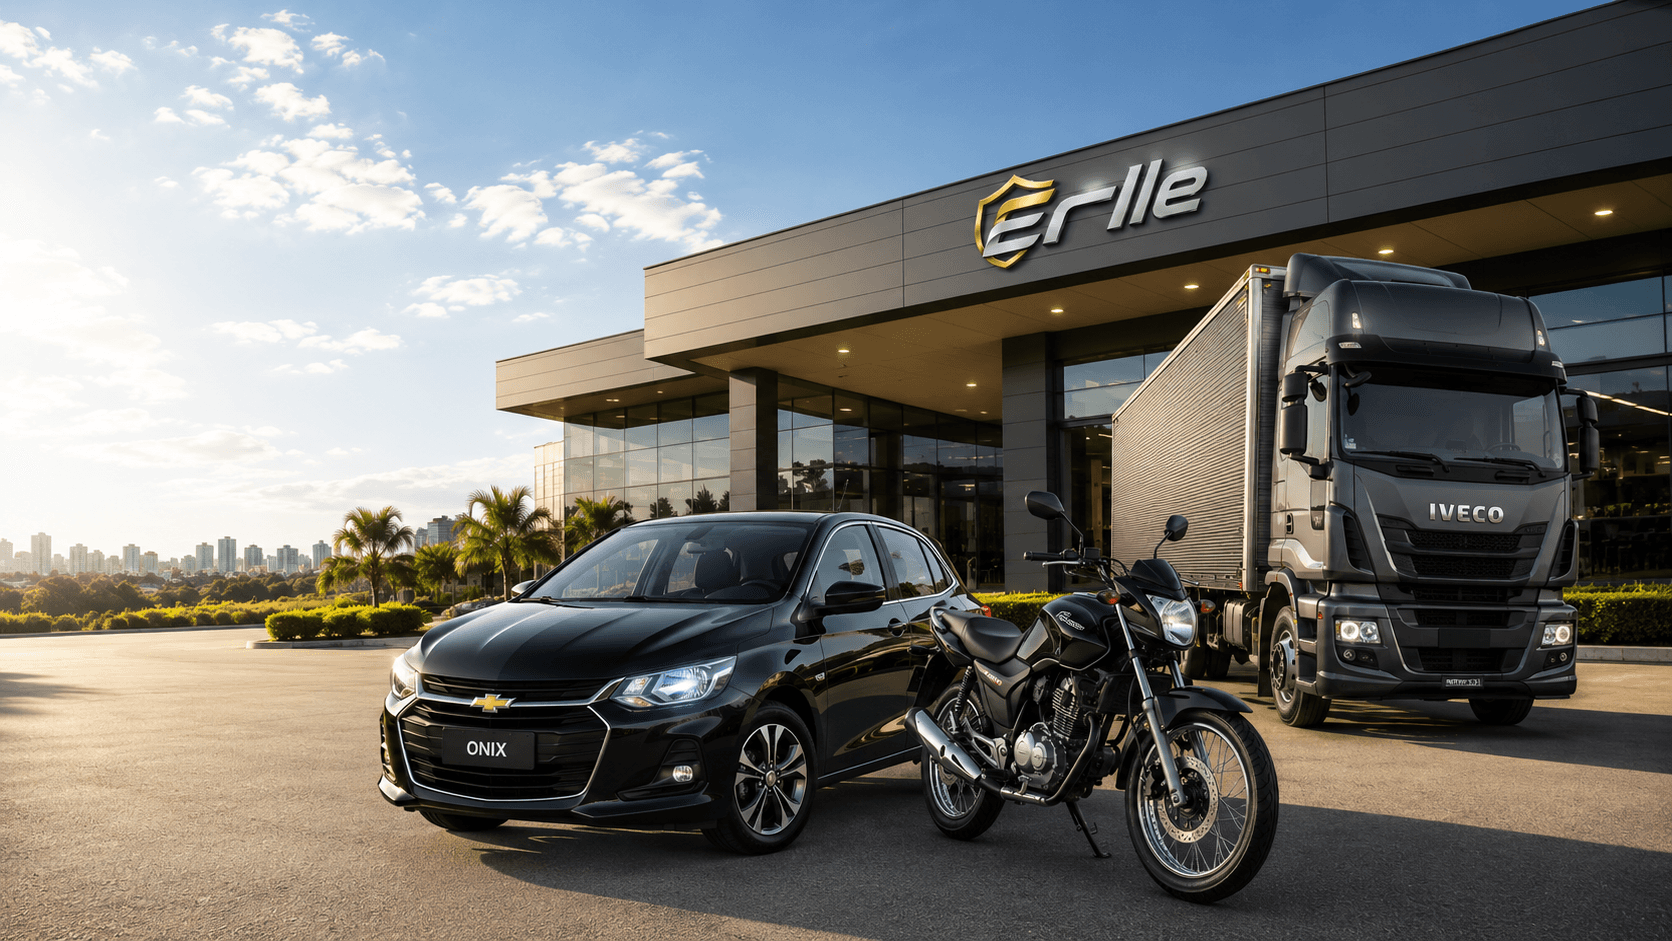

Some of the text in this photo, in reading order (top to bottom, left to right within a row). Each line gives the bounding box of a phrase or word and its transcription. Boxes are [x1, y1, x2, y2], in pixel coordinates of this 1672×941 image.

[982, 159, 1207, 258] Erlle
[1429, 503, 1504, 523] IVECO
[466, 740, 507, 757] ONIX
